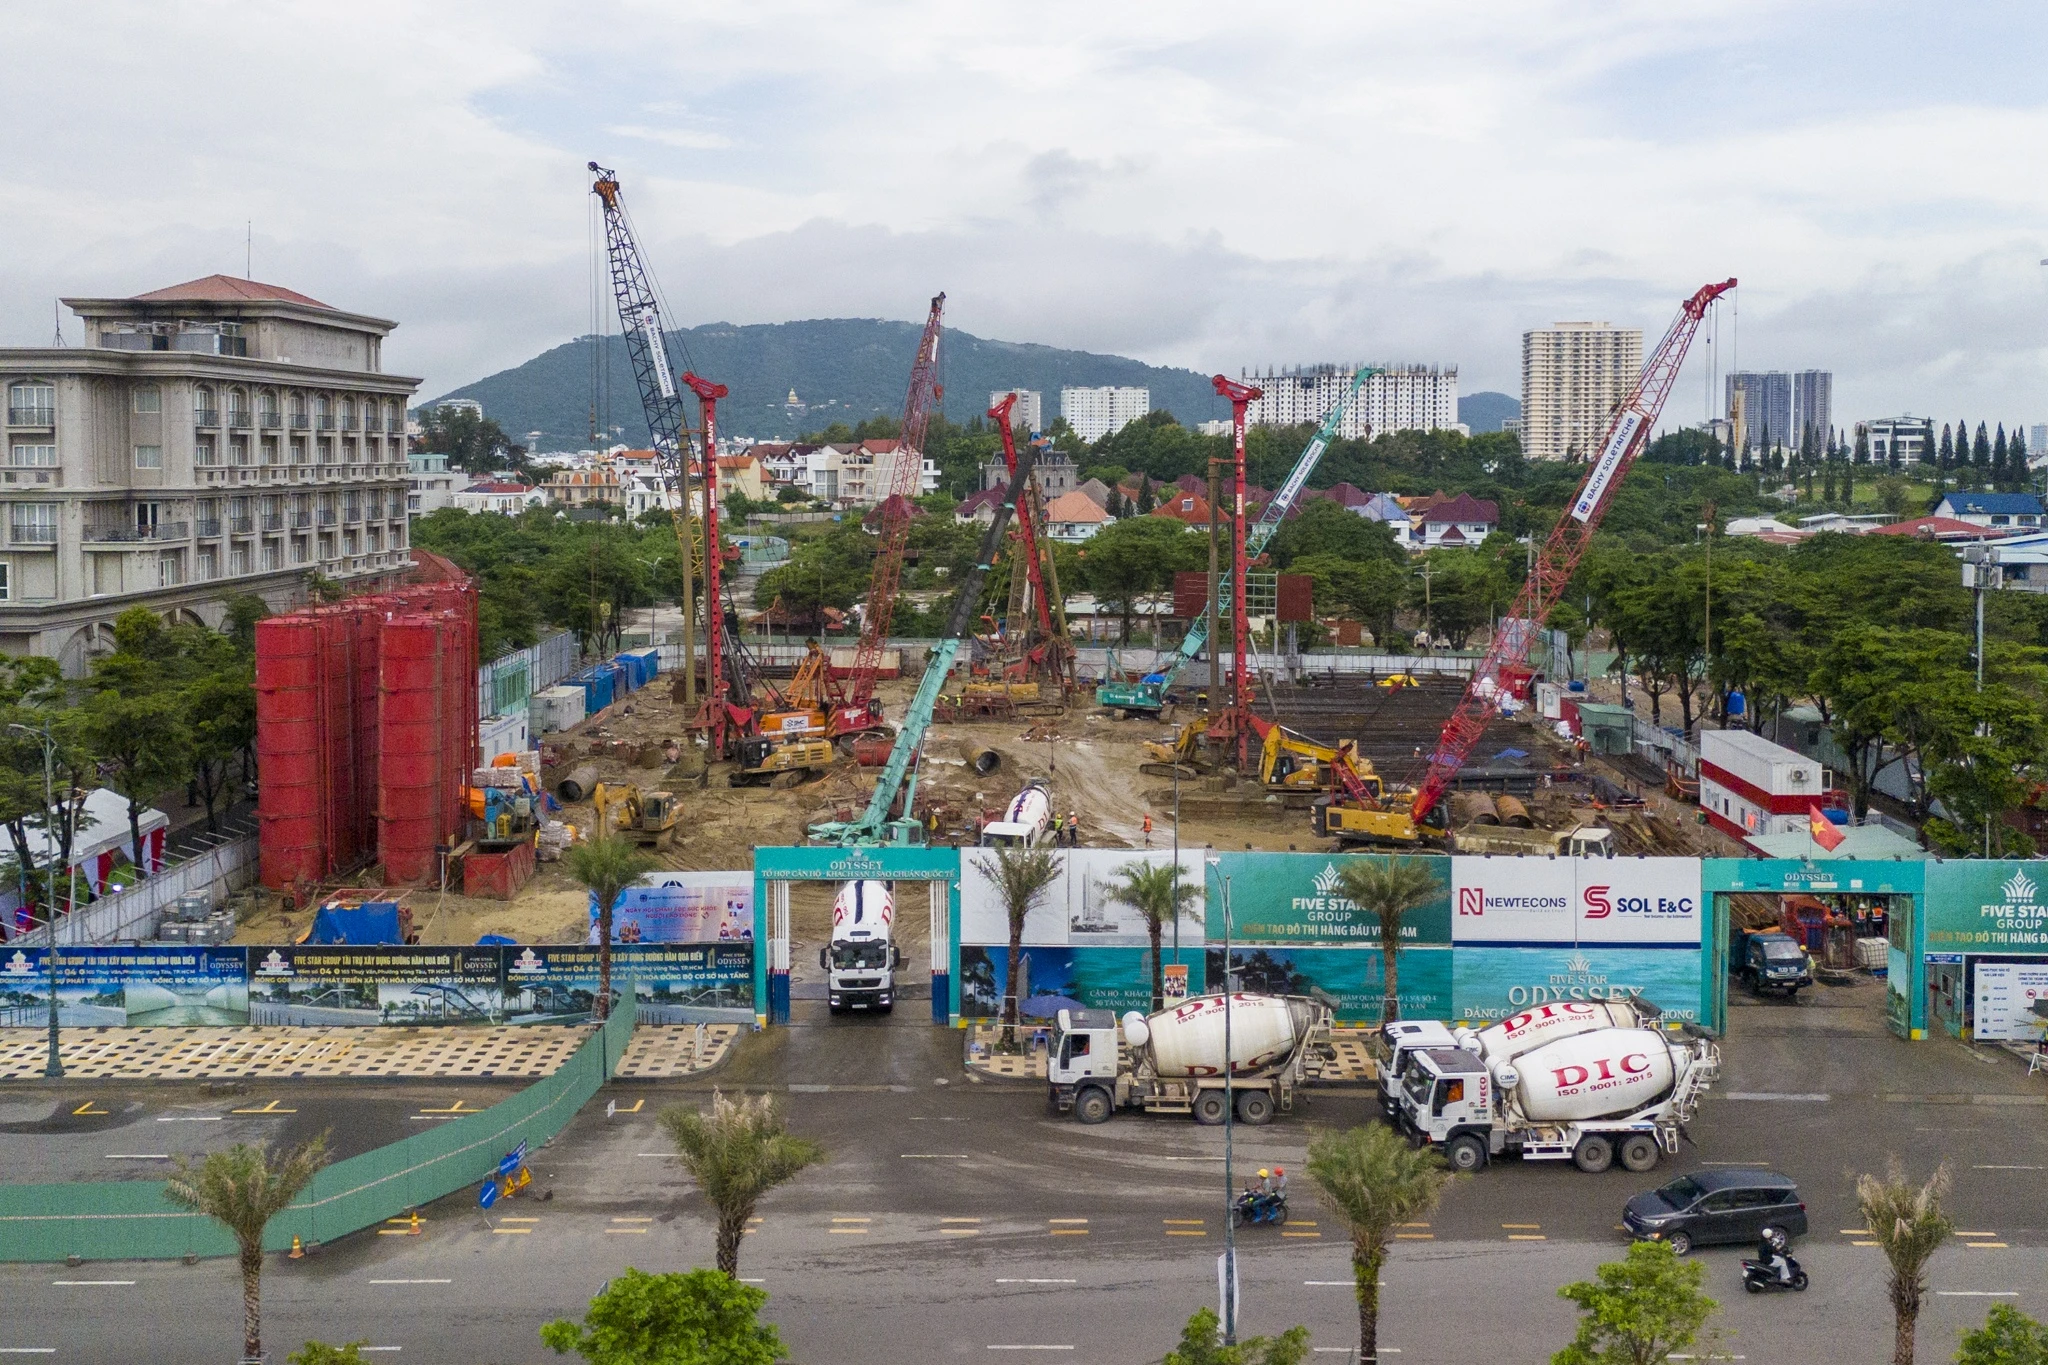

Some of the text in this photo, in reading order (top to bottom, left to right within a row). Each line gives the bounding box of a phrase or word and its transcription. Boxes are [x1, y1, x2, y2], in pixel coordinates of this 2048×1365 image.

[649, 327, 659, 349] BACHY
[1587, 417, 1635, 500] BACHY SOLETANCHE
[1287, 476, 1300, 494] BACHY
[830, 860, 884, 870] ODYSSEY
[1785, 873, 1835, 882] ODYSSEY
[1292, 898, 1325, 910] FIVE
[1485, 897, 1567, 908] NEWTECONS
[1617, 898, 1652, 913] SOL
[1658, 898, 1693, 913] E&C
[1307, 911, 1352, 922] GROUP
[1980, 905, 2015, 918] FIVE
[1996, 918, 2043, 929] GROUP
[1267, 925, 1284, 937] TẠO
[1286, 923, 1300, 935] ĐÔ
[1302, 925, 1319, 937] THỊ
[1320, 922, 1347, 936] HÀNG
[1350, 922, 1369, 937] ĐẦU
[1975, 930, 1989, 943] ĐÔ
[1991, 932, 2008, 946] THỊ
[2010, 931, 2038, 944] HÀNG
[294, 956, 306, 965] FIVE
[307, 956, 321, 965] STAR
[322, 956, 341, 965] GROUP
[548, 954, 559, 962] FIVE
[561, 954, 575, 962] STAR
[210, 961, 244, 969] ODYSSEY
[573, 965, 585, 973] 04
[508, 974, 529, 982] ĐÓNG
[682, 973, 693, 981] BỘ
[730, 971, 750, 979] TẦNG
[1549, 975, 1607, 984] FIVE STAR
[1090, 989, 1106, 997] CĂN
[1124, 989, 1151, 997] KHÁCH
[1177, 1014, 1196, 1024] ISO
[1502, 1003, 1594, 1035] DIC
[1506, 1029, 1526, 1040] ISO
[1568, 1013, 1595, 1021] 2015
[1550, 1053, 1651, 1089] DIC
[1557, 1088, 1579, 1097] ISO
[1625, 1071, 1653, 1084] 2015
[1479, 1076, 1487, 1108] IVECO
